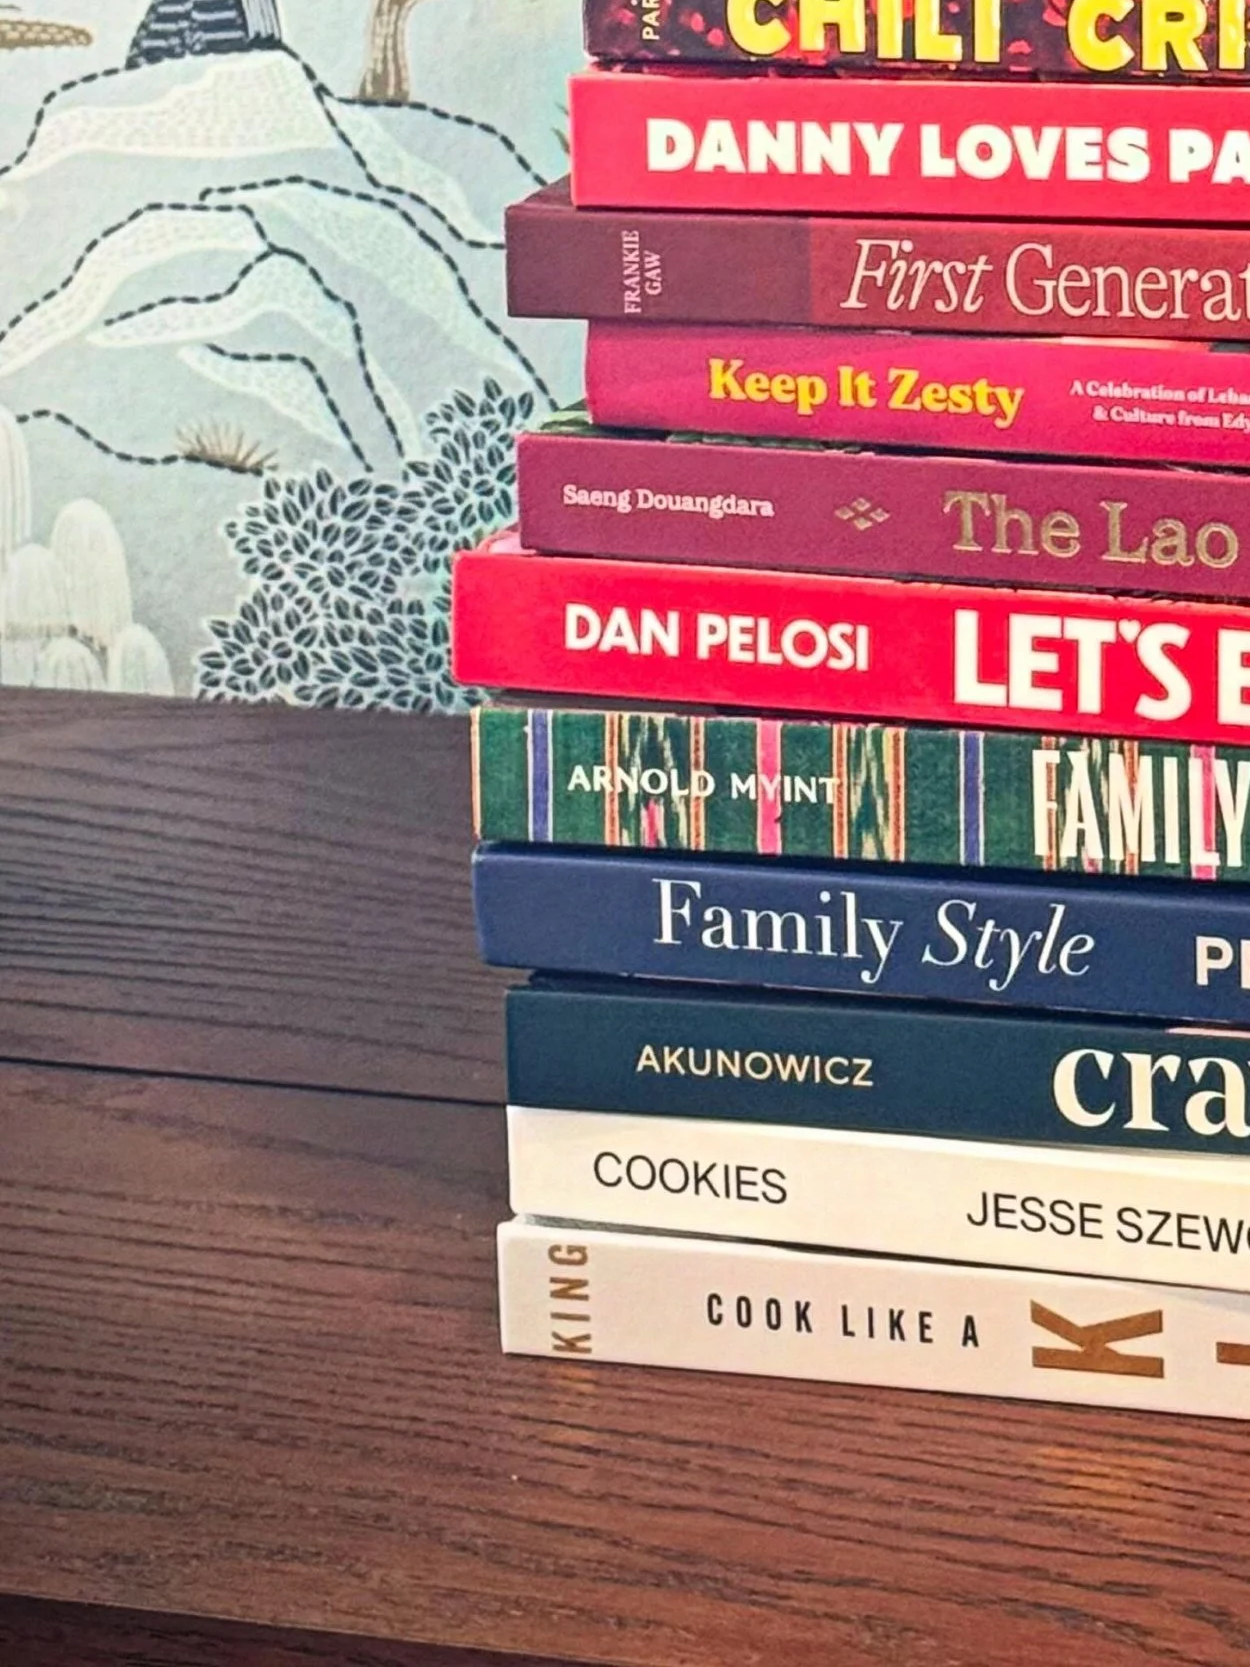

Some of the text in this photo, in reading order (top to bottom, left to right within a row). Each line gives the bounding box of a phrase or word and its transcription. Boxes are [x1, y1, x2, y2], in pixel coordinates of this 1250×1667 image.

[645, 117, 904, 176] DANNY
[919, 123, 1150, 180] LOVES
[622, 230, 642, 313] FRANKIE
[643, 250, 662, 295] GAW
[841, 238, 993, 314] First
[708, 358, 1025, 429] Keep It Zesty
[1070, 380, 1084, 396] A
[1086, 381, 1185, 402] Celebration
[1187, 387, 1207, 404] of
[1092, 405, 1108, 421] &
[1109, 405, 1176, 426] Culture
[1177, 409, 1220, 429] from
[562, 484, 775, 519] Saeng Douangdara
[943, 490, 1081, 558] The
[1100, 500, 1239, 567] Lao
[564, 601, 870, 673] DAN PELOSI
[954, 608, 1192, 722] LET'S
[567, 765, 840, 805] ARNOLD MYINT
[652, 878, 1095, 991] Family Style
[636, 1045, 873, 1088] AKUNOWICZ
[593, 1151, 787, 1205] COOKIES
[967, 1192, 1103, 1239] JESSE
[547, 1242, 593, 1355] KING
[706, 1292, 813, 1333] COOK
[841, 1305, 934, 1344] LIKE
[962, 1314, 980, 1347] A
